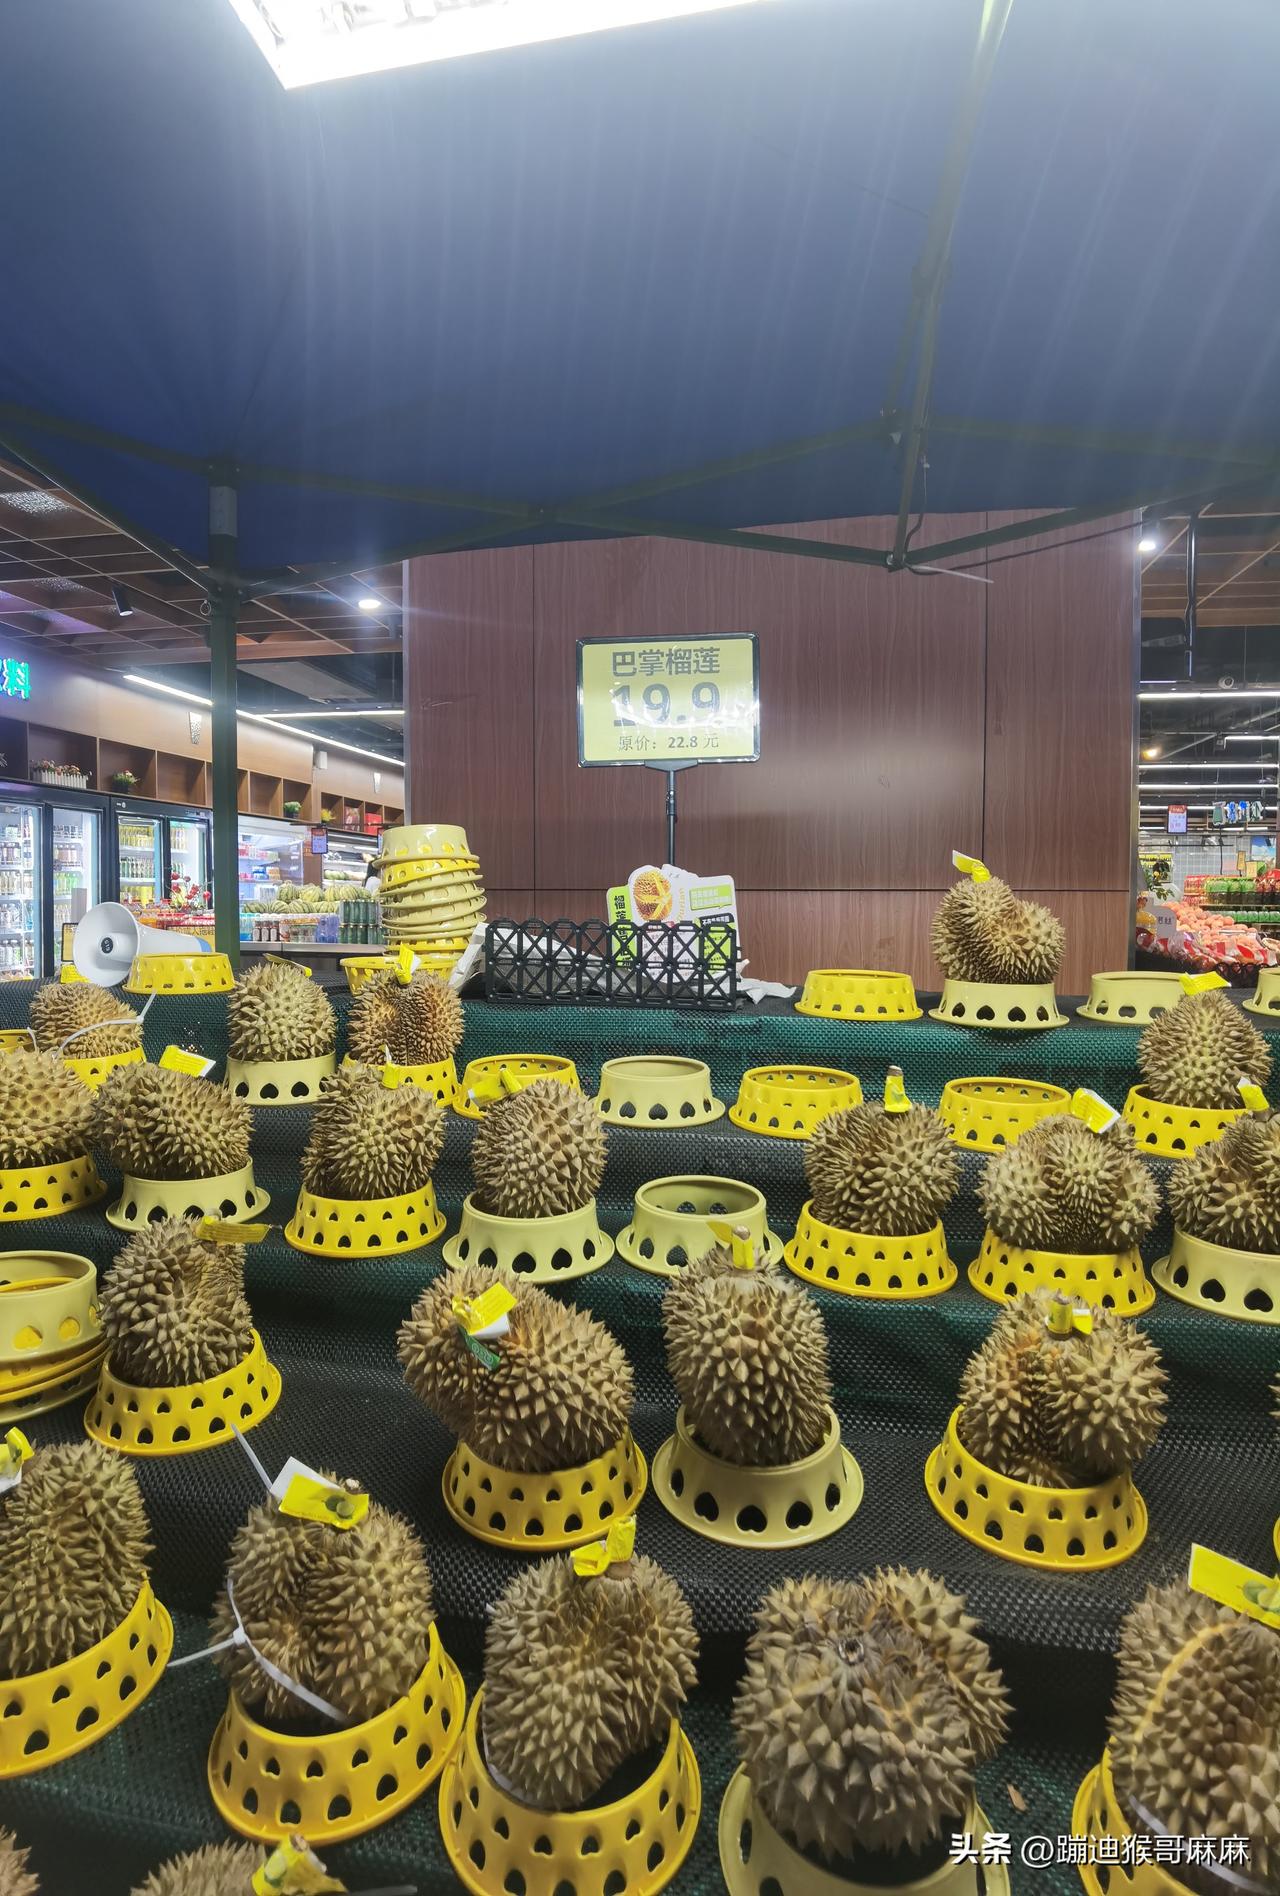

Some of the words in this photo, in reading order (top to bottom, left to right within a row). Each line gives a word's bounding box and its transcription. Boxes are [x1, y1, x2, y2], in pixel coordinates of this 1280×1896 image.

[0, 658, 32, 699] 料
[612, 646, 720, 677] 巴掌榴莲
[612, 682, 721, 727] 19.9
[668, 735, 698, 749] 22.8
